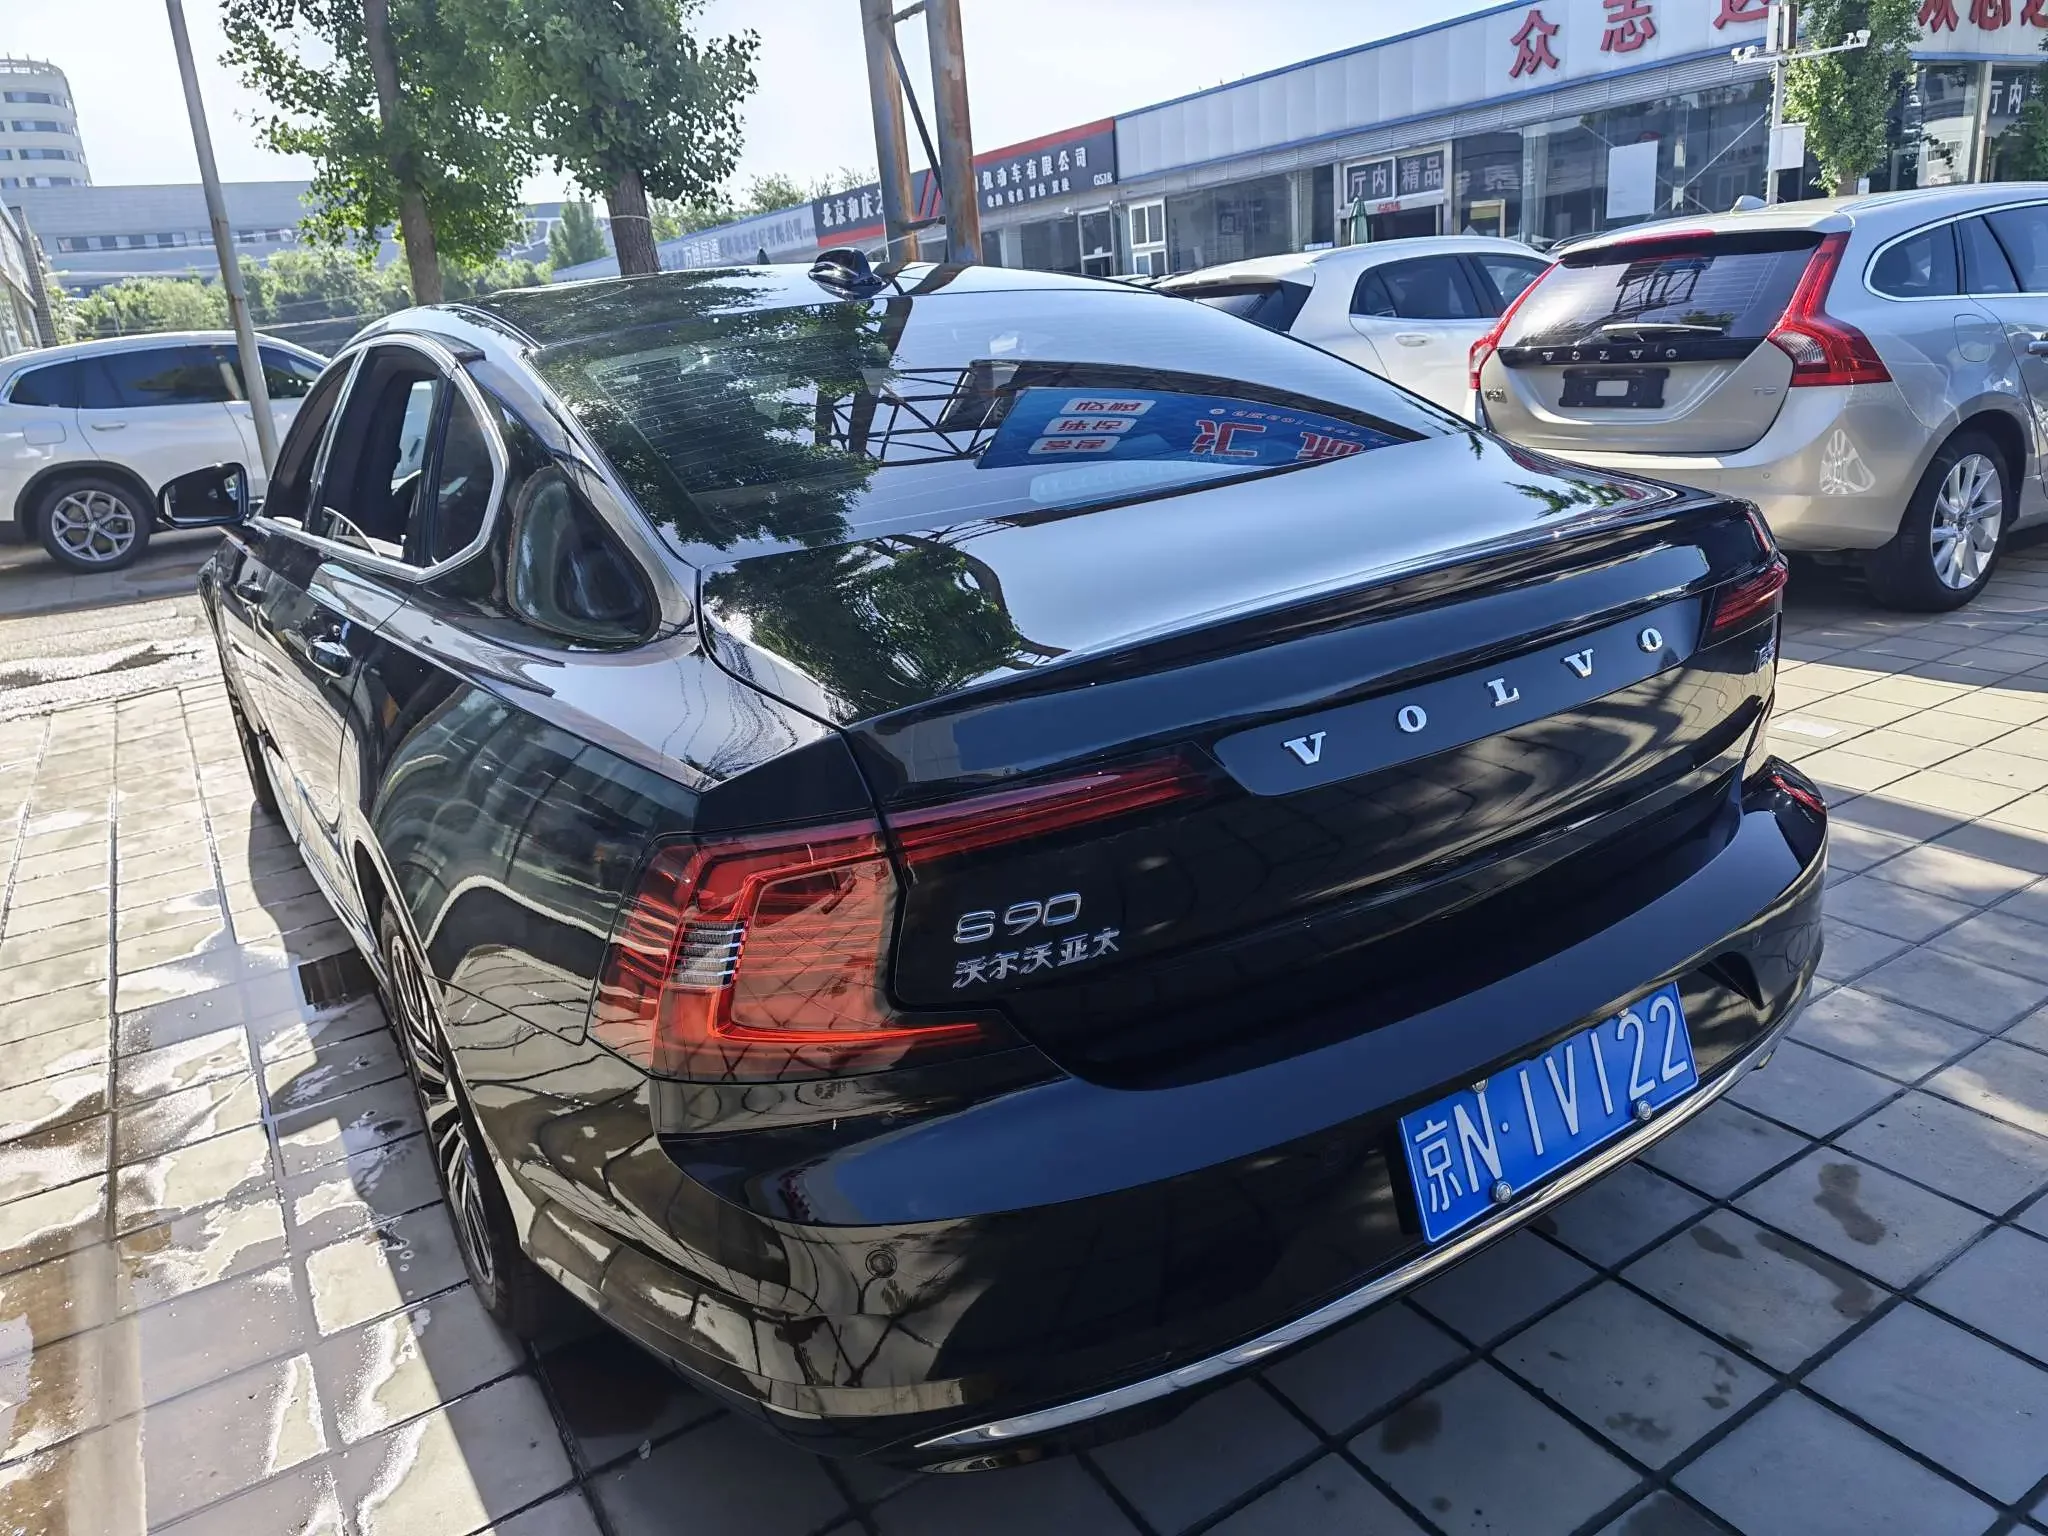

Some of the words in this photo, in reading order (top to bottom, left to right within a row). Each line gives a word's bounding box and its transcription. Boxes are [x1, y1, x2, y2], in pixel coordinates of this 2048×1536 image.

[975, 147, 1087, 190] 机动车有限公司
[1350, 155, 1442, 196] 厅内精品
[1542, 348, 1678, 360] VOLVO
[1281, 626, 1664, 766] VOLVO
[953, 891, 1082, 944] S90
[953, 927, 1121, 989] 沃尔沃亚太
